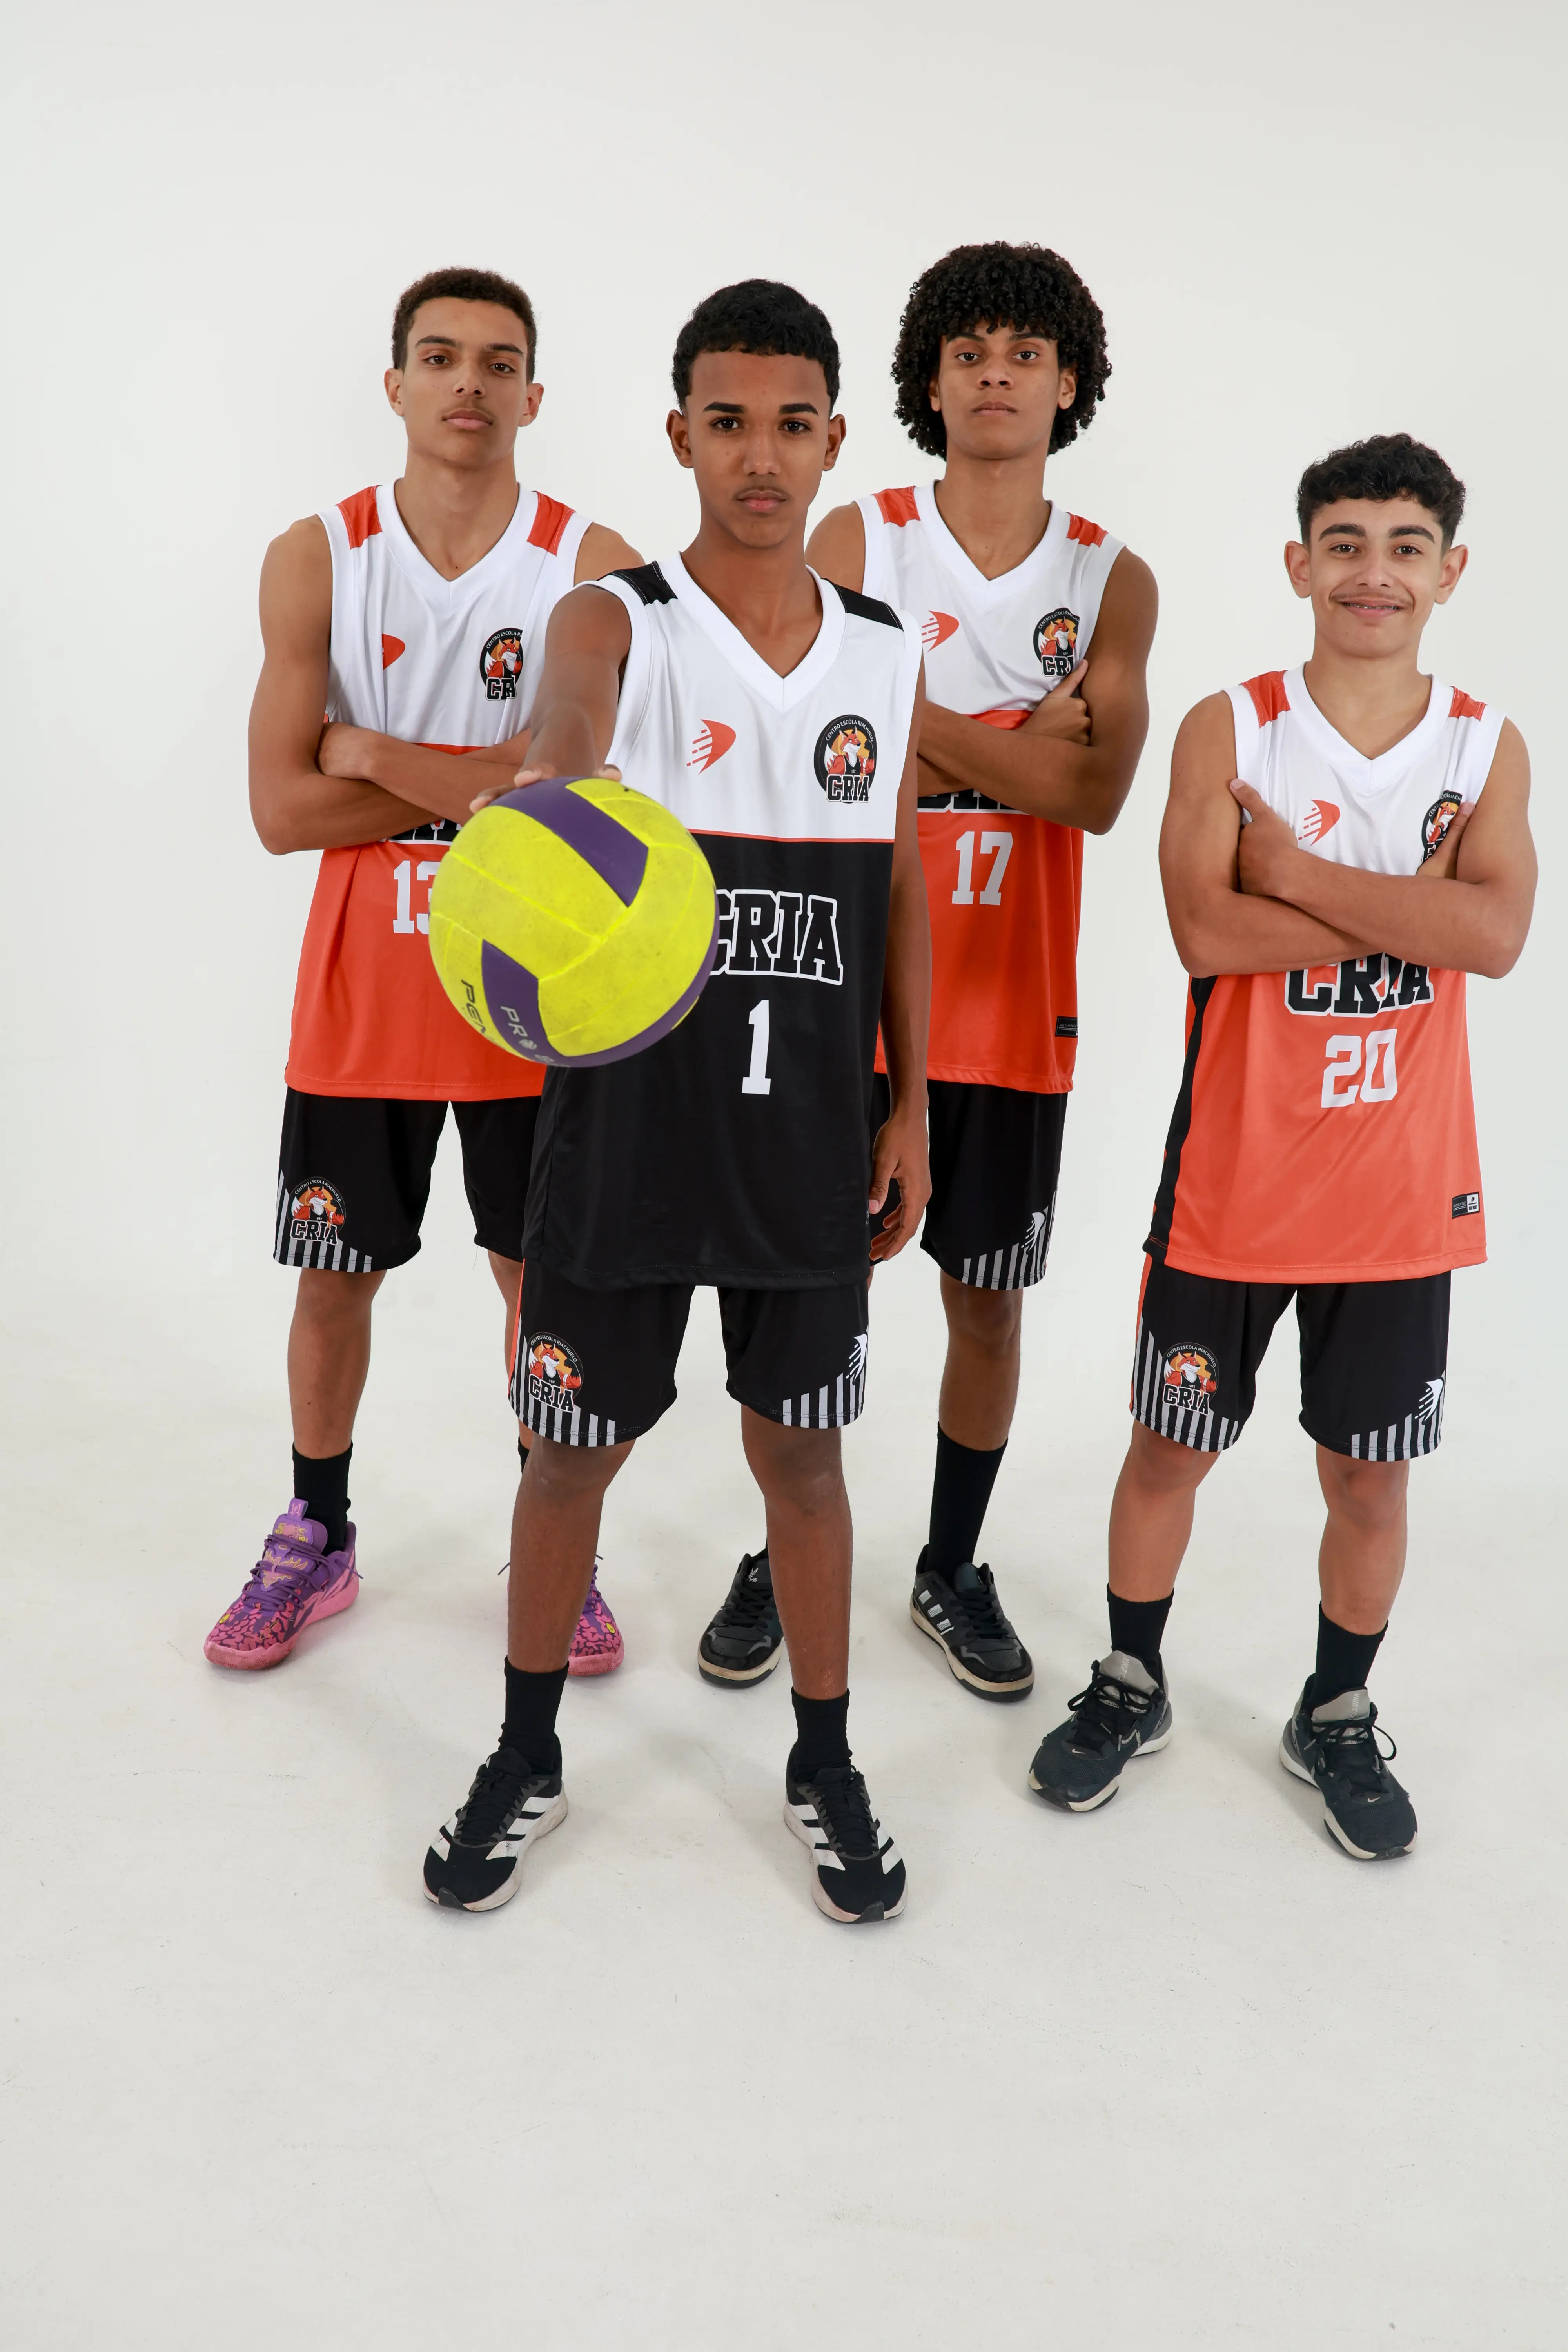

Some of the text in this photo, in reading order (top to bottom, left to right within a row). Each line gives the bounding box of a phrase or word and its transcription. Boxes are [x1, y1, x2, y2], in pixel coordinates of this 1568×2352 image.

[1038, 616, 1051, 629] CENTRO
[486, 634, 500, 649] CENTRO
[826, 724, 840, 741] CENTRO
[858, 721, 873, 742] RIACHUELO
[826, 774, 869, 802] CRIA
[1428, 804, 1440, 817] CENTR
[952, 831, 1013, 905] 17
[742, 1000, 771, 1095] 1
[1321, 1029, 1397, 1108] 20
[295, 1182, 309, 1194] CENTRO
[325, 1183, 341, 1202] RIACHUELO
[290, 1219, 338, 1246] CRIA
[531, 1335, 542, 1346] CENTRO
[557, 1340, 577, 1362] RIACHUELO
[1167, 1347, 1180, 1357] CENTRO
[1198, 1347, 1216, 1367] RIACHUELO
[528, 1373, 575, 1413] CRIA
[1162, 1383, 1210, 1416] CRIA
